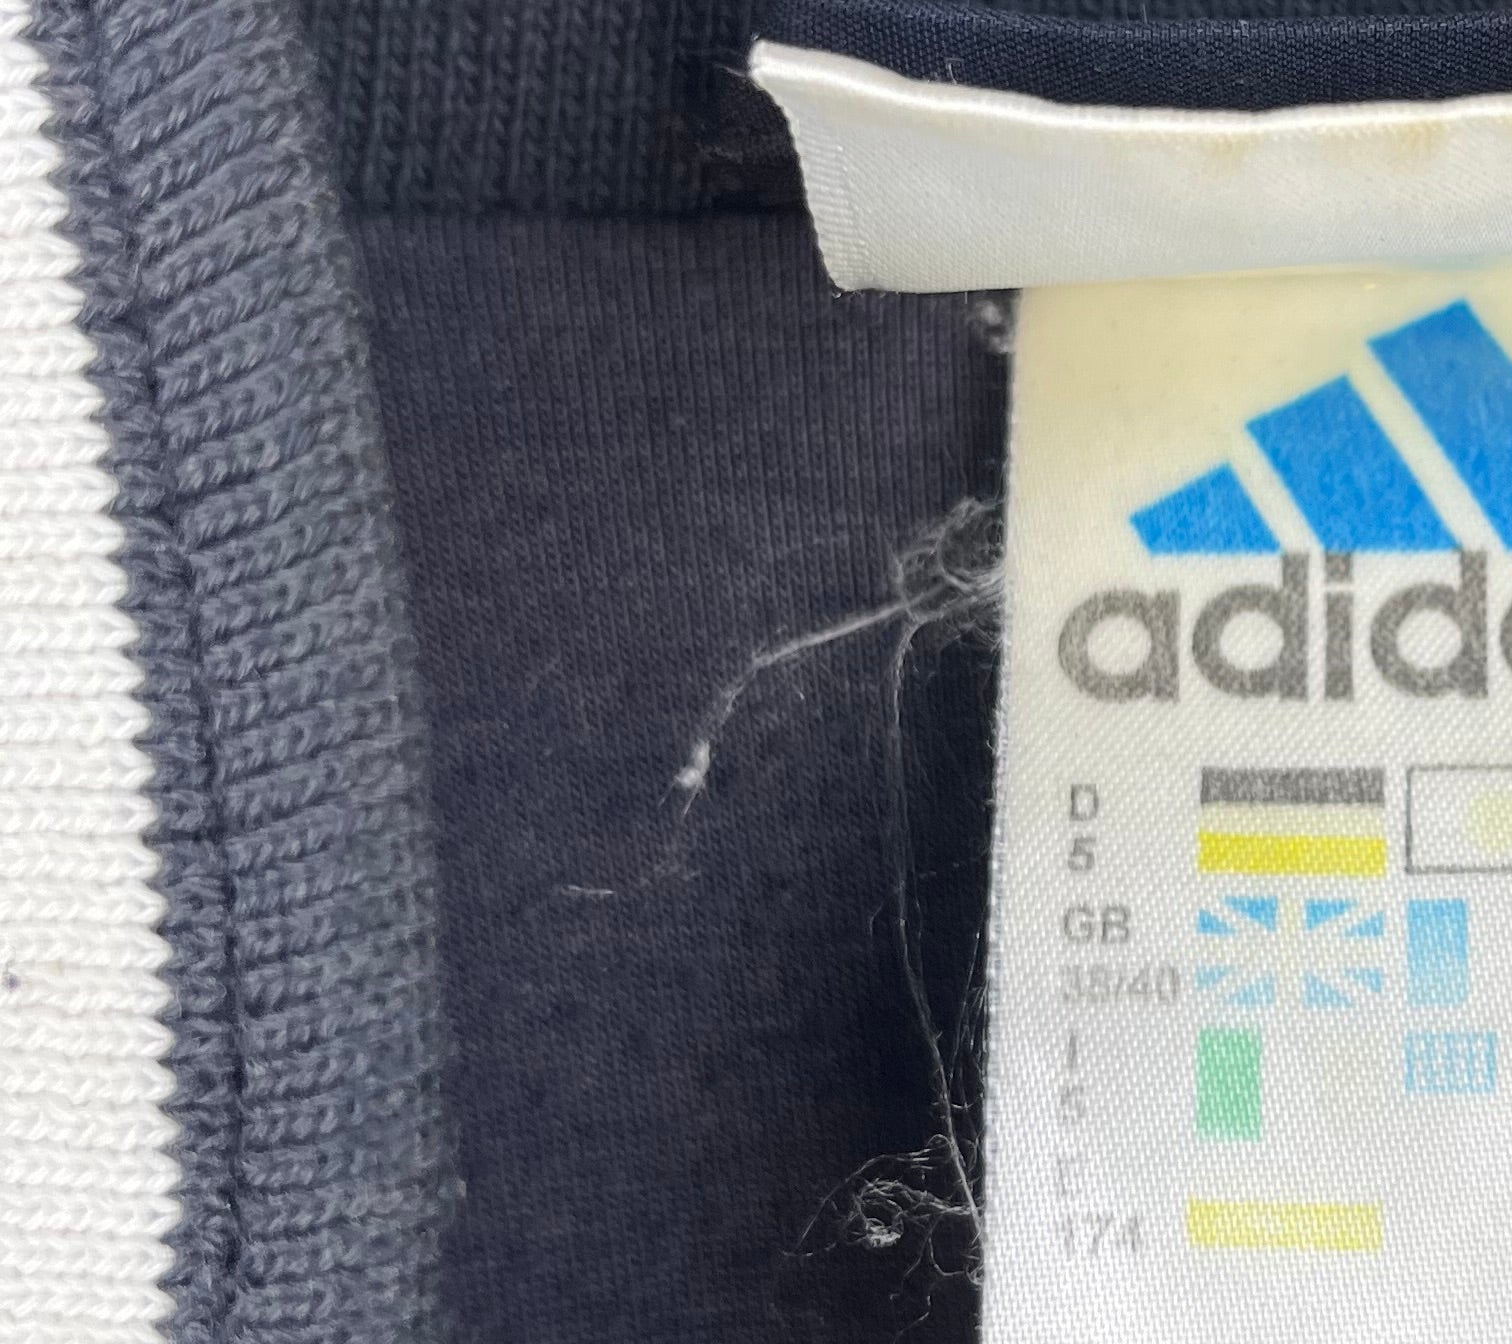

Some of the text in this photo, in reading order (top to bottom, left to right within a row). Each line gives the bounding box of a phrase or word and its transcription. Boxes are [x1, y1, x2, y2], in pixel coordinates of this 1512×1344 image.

[1069, 783, 1100, 822] D
[1067, 835, 1097, 872] 5
[1062, 903, 1132, 945] GB
[1061, 962, 1182, 1007] 38/40
[1056, 1209, 1146, 1256] 174
